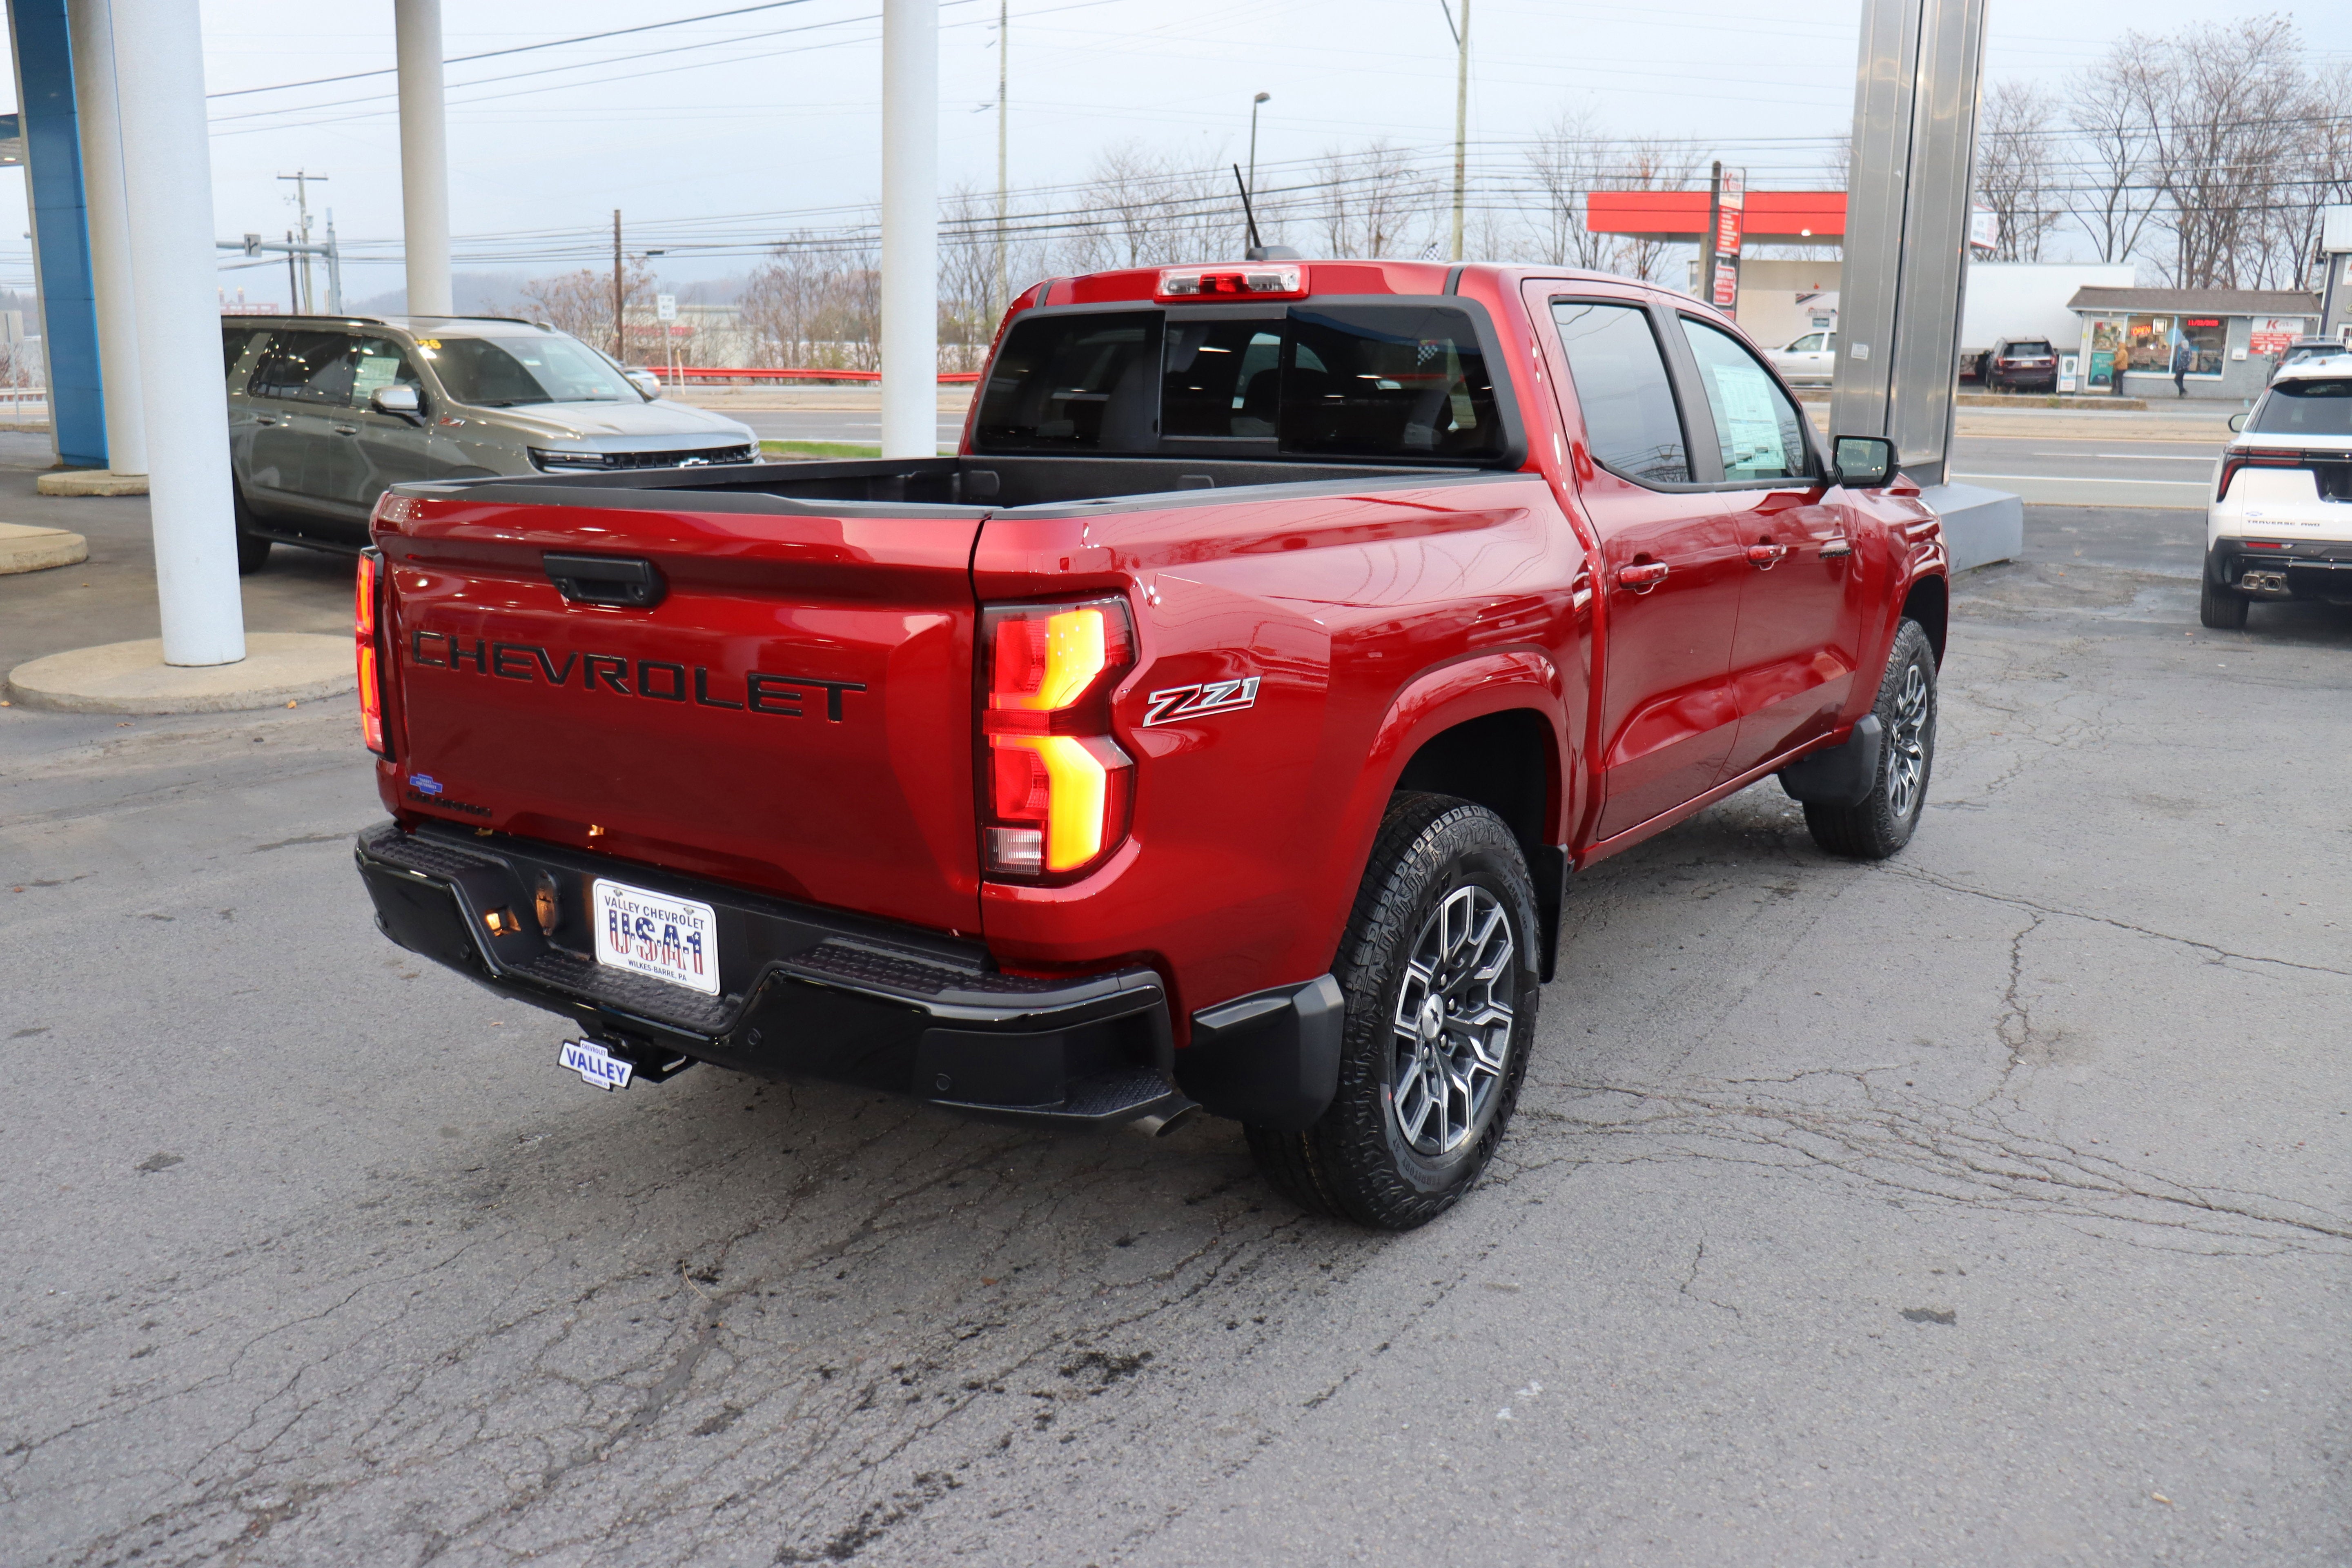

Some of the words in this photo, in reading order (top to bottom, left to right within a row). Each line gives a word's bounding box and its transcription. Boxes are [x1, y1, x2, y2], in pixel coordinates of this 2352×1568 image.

[2131, 325, 2152, 336] OPEN
[439, 417, 466, 428] Z71
[412, 630, 866, 724] CHEVROLET
[1143, 676, 1261, 727] Z71
[604, 895, 639, 913] VALLEY
[643, 906, 704, 930] CHEVROLET
[628, 959, 677, 980] WILKES-BARRE,
[678, 973, 687, 982] PA
[581, 1043, 606, 1056] CHEVROLET
[566, 1047, 626, 1084] VALLEY
